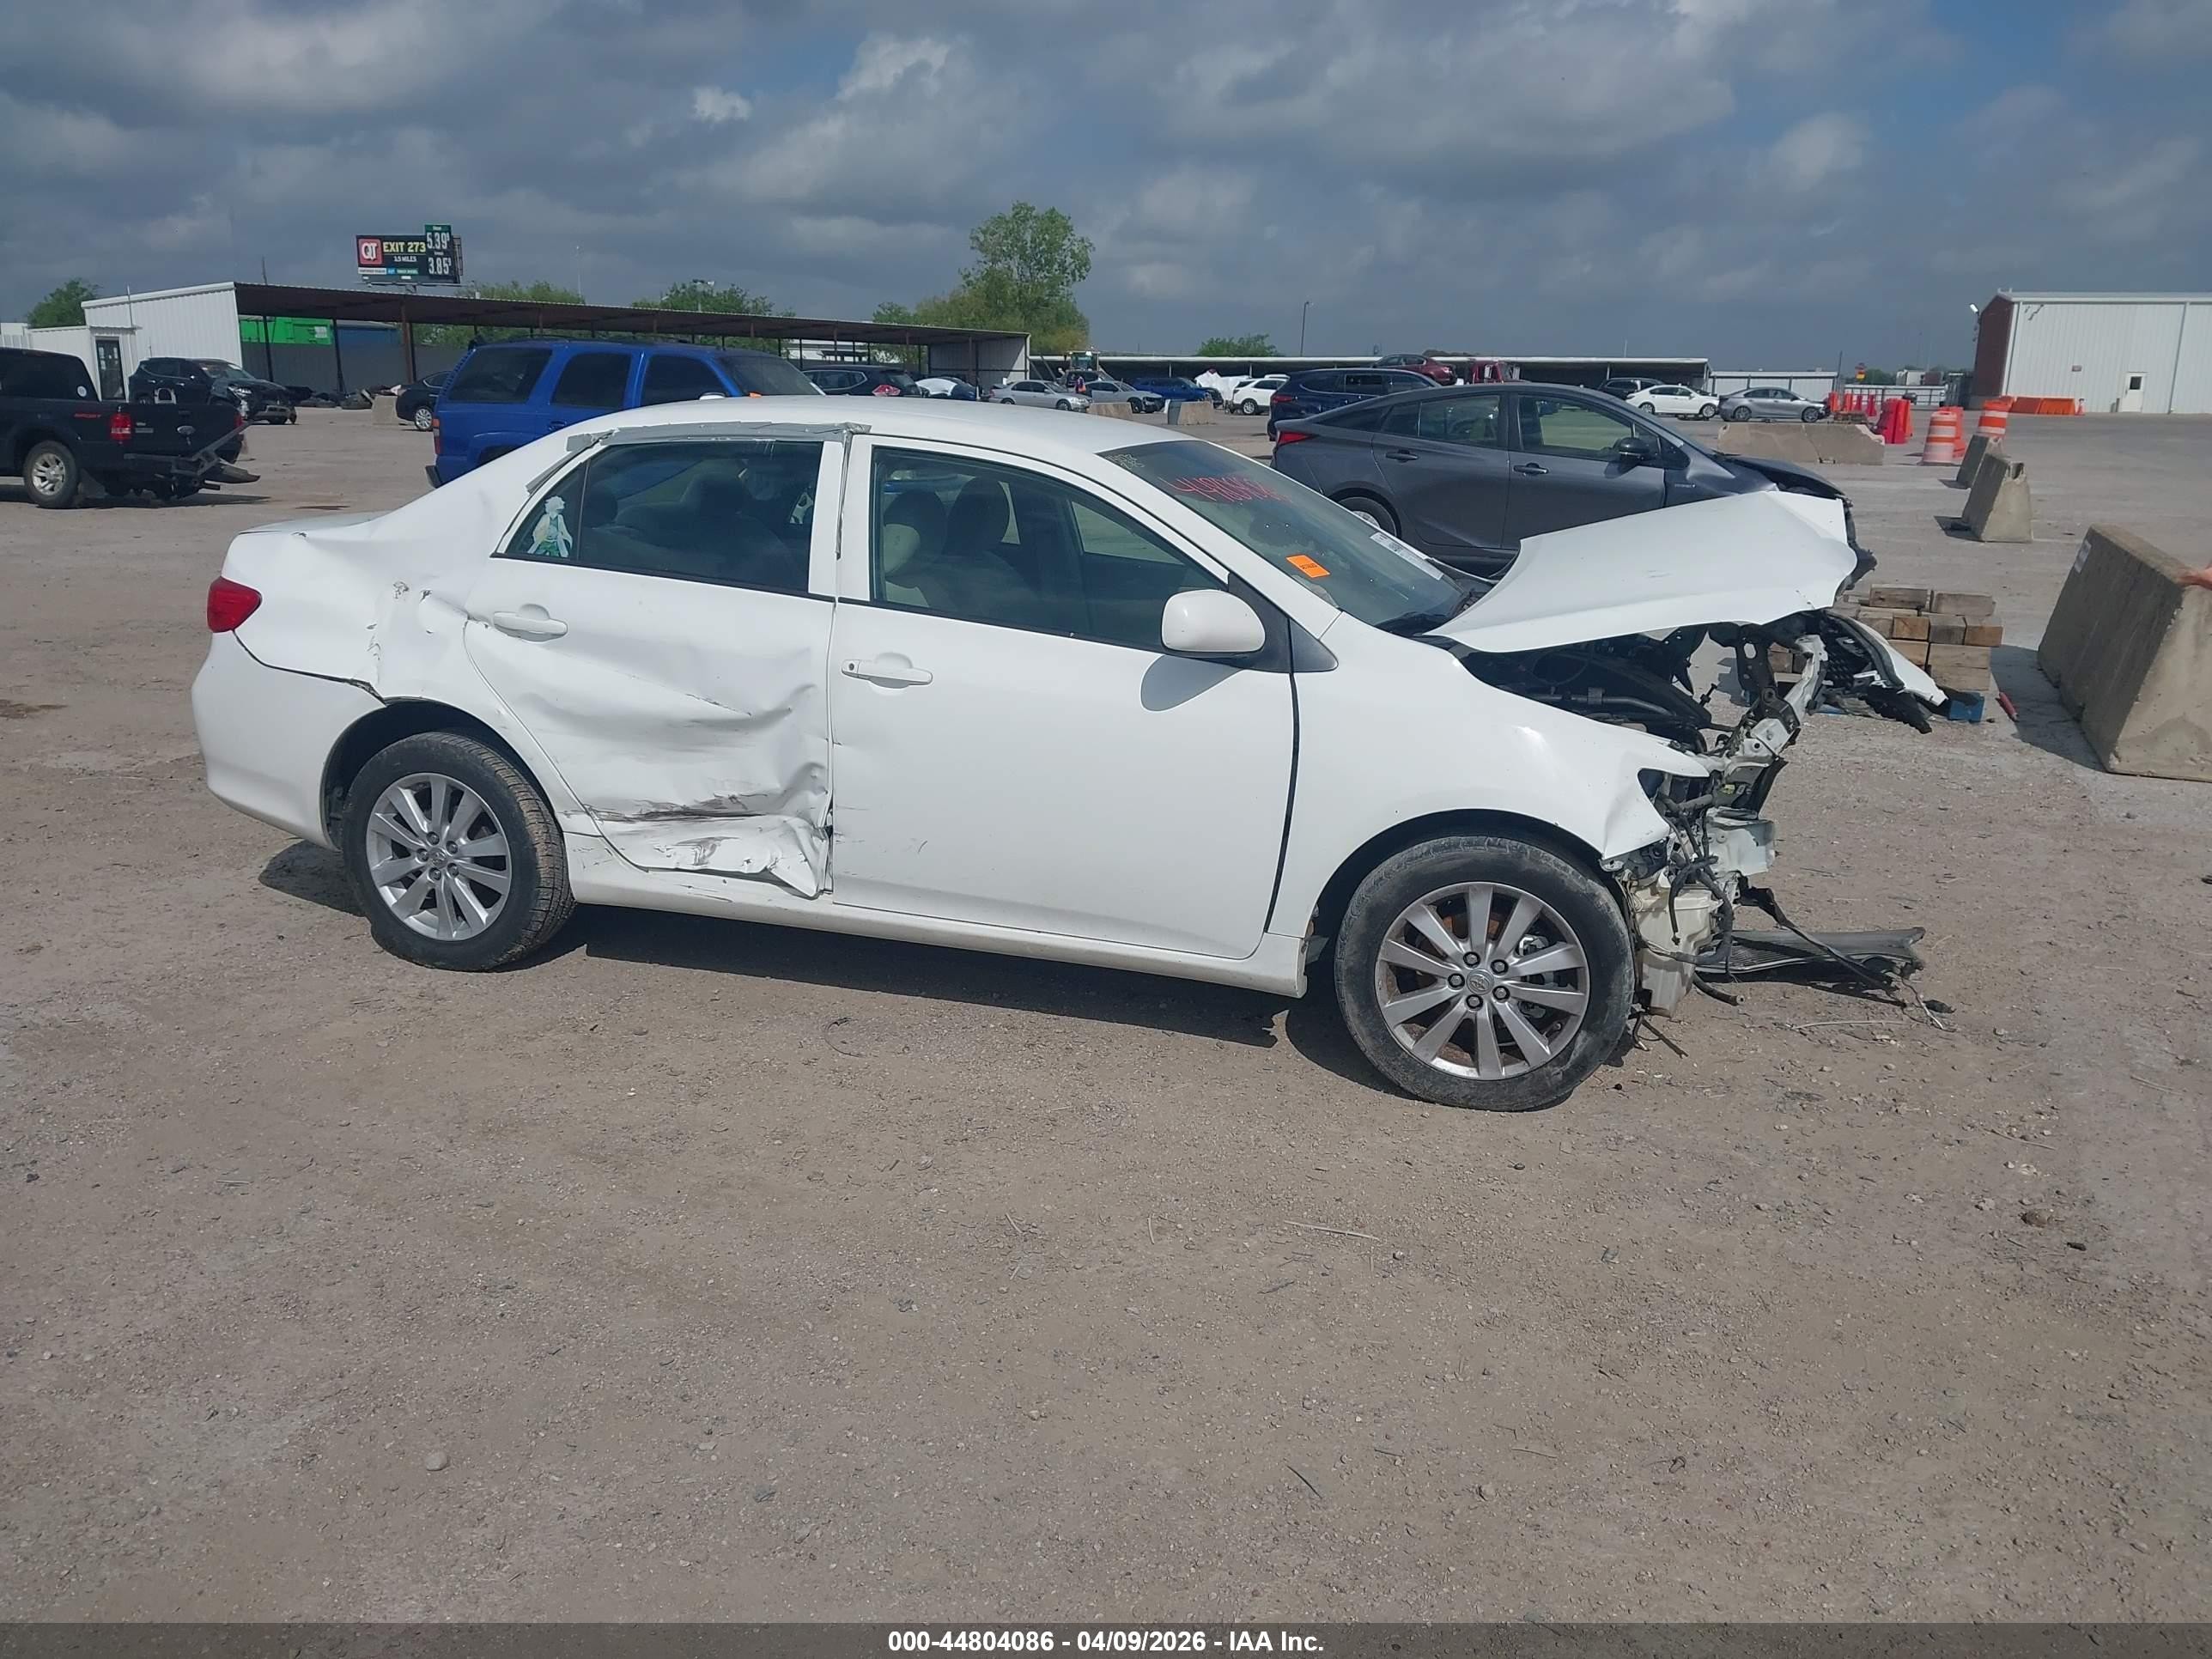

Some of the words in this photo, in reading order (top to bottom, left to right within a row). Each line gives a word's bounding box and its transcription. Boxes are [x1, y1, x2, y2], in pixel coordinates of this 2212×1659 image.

[362, 242, 377, 260] QT
[383, 241, 405, 252] EXIT
[407, 241, 427, 252] 273
